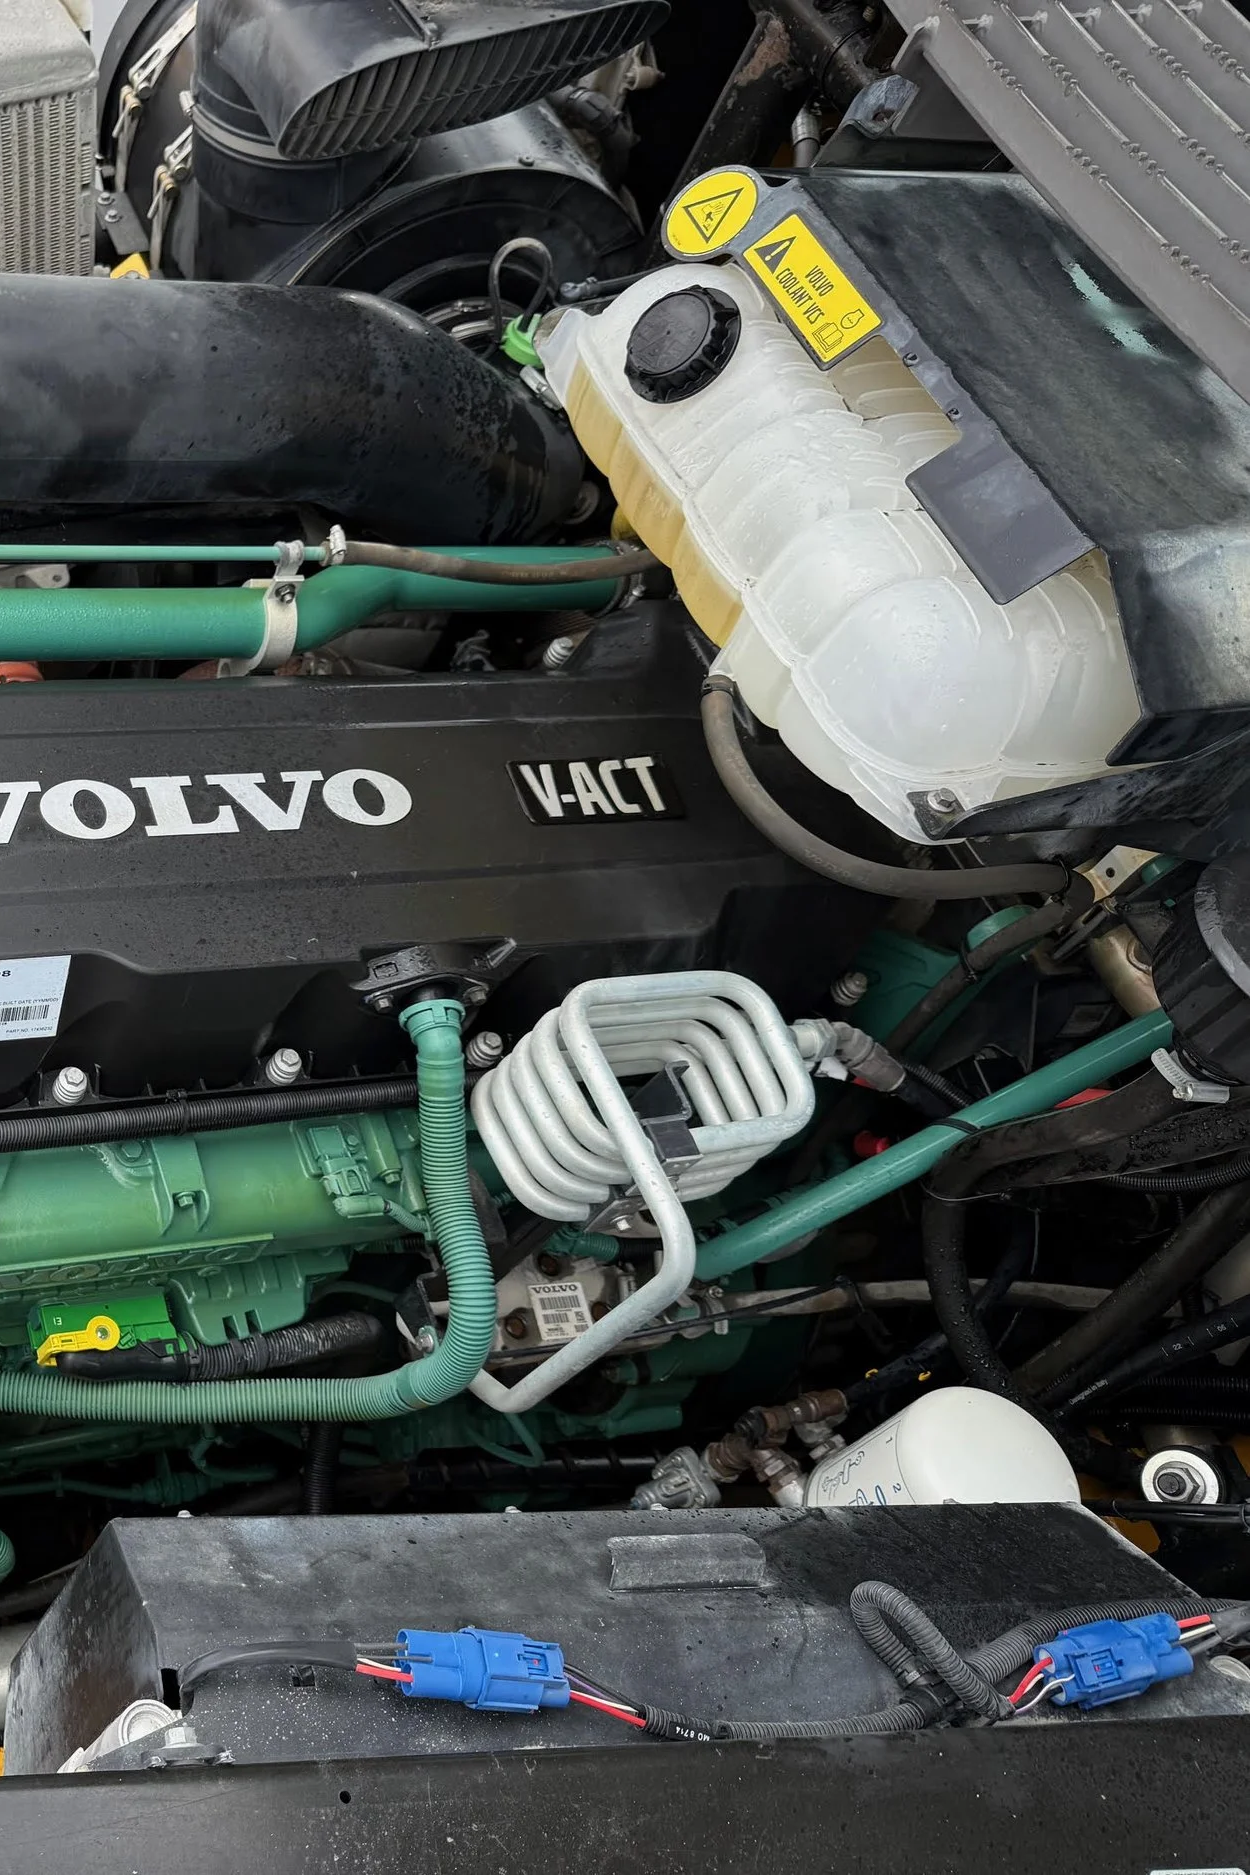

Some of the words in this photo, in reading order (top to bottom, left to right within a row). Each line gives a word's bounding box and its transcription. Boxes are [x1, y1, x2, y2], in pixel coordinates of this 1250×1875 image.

[775, 267, 813, 308] COOLANT
[802, 302, 826, 325] VCS
[804, 265, 835, 296] VOLVO
[519, 756, 668, 818] V-ACT
[531, 1283, 578, 1294] VOLVO
[892, 1482, 902, 1493] 2
